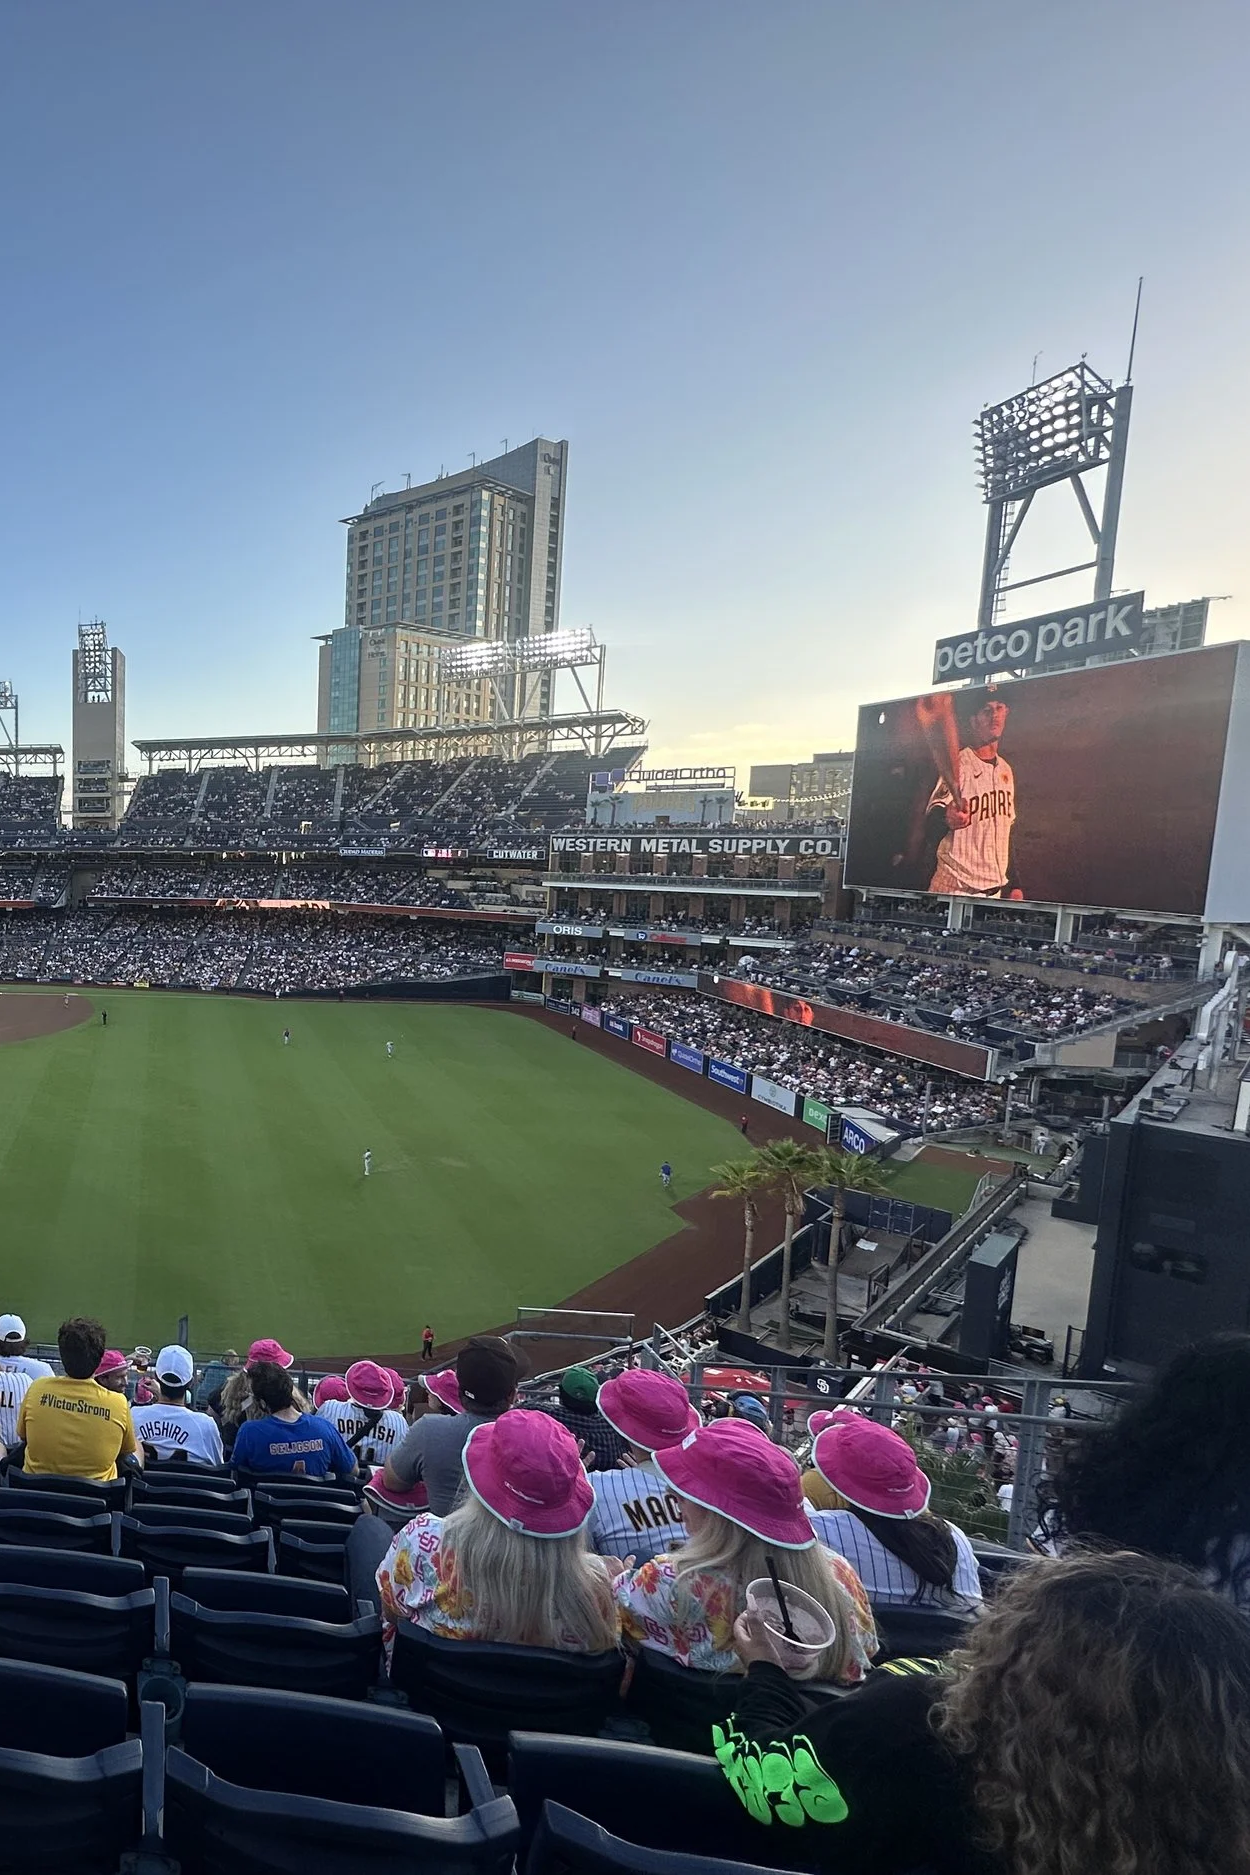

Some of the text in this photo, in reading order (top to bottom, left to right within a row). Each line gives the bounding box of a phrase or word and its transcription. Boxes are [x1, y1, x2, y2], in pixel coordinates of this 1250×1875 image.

[935, 603, 1134, 681] petco park
[630, 766, 726, 784] QuidelOrtho
[493, 850, 538, 859] CUTWATER
[552, 838, 838, 855] WESTERN METAL SUPPLY CO.
[553, 925, 583, 936] ORIS
[711, 1064, 740, 1084] Southwest
[843, 1126, 865, 1155] ARCO
[816, 1378, 830, 1394] SD
[39, 1393, 111, 1421] #VictorStrong
[139, 1421, 189, 1445] OHSHIRO
[338, 1418, 396, 1445] DARISH
[269, 1439, 324, 1456] SELIGSON
